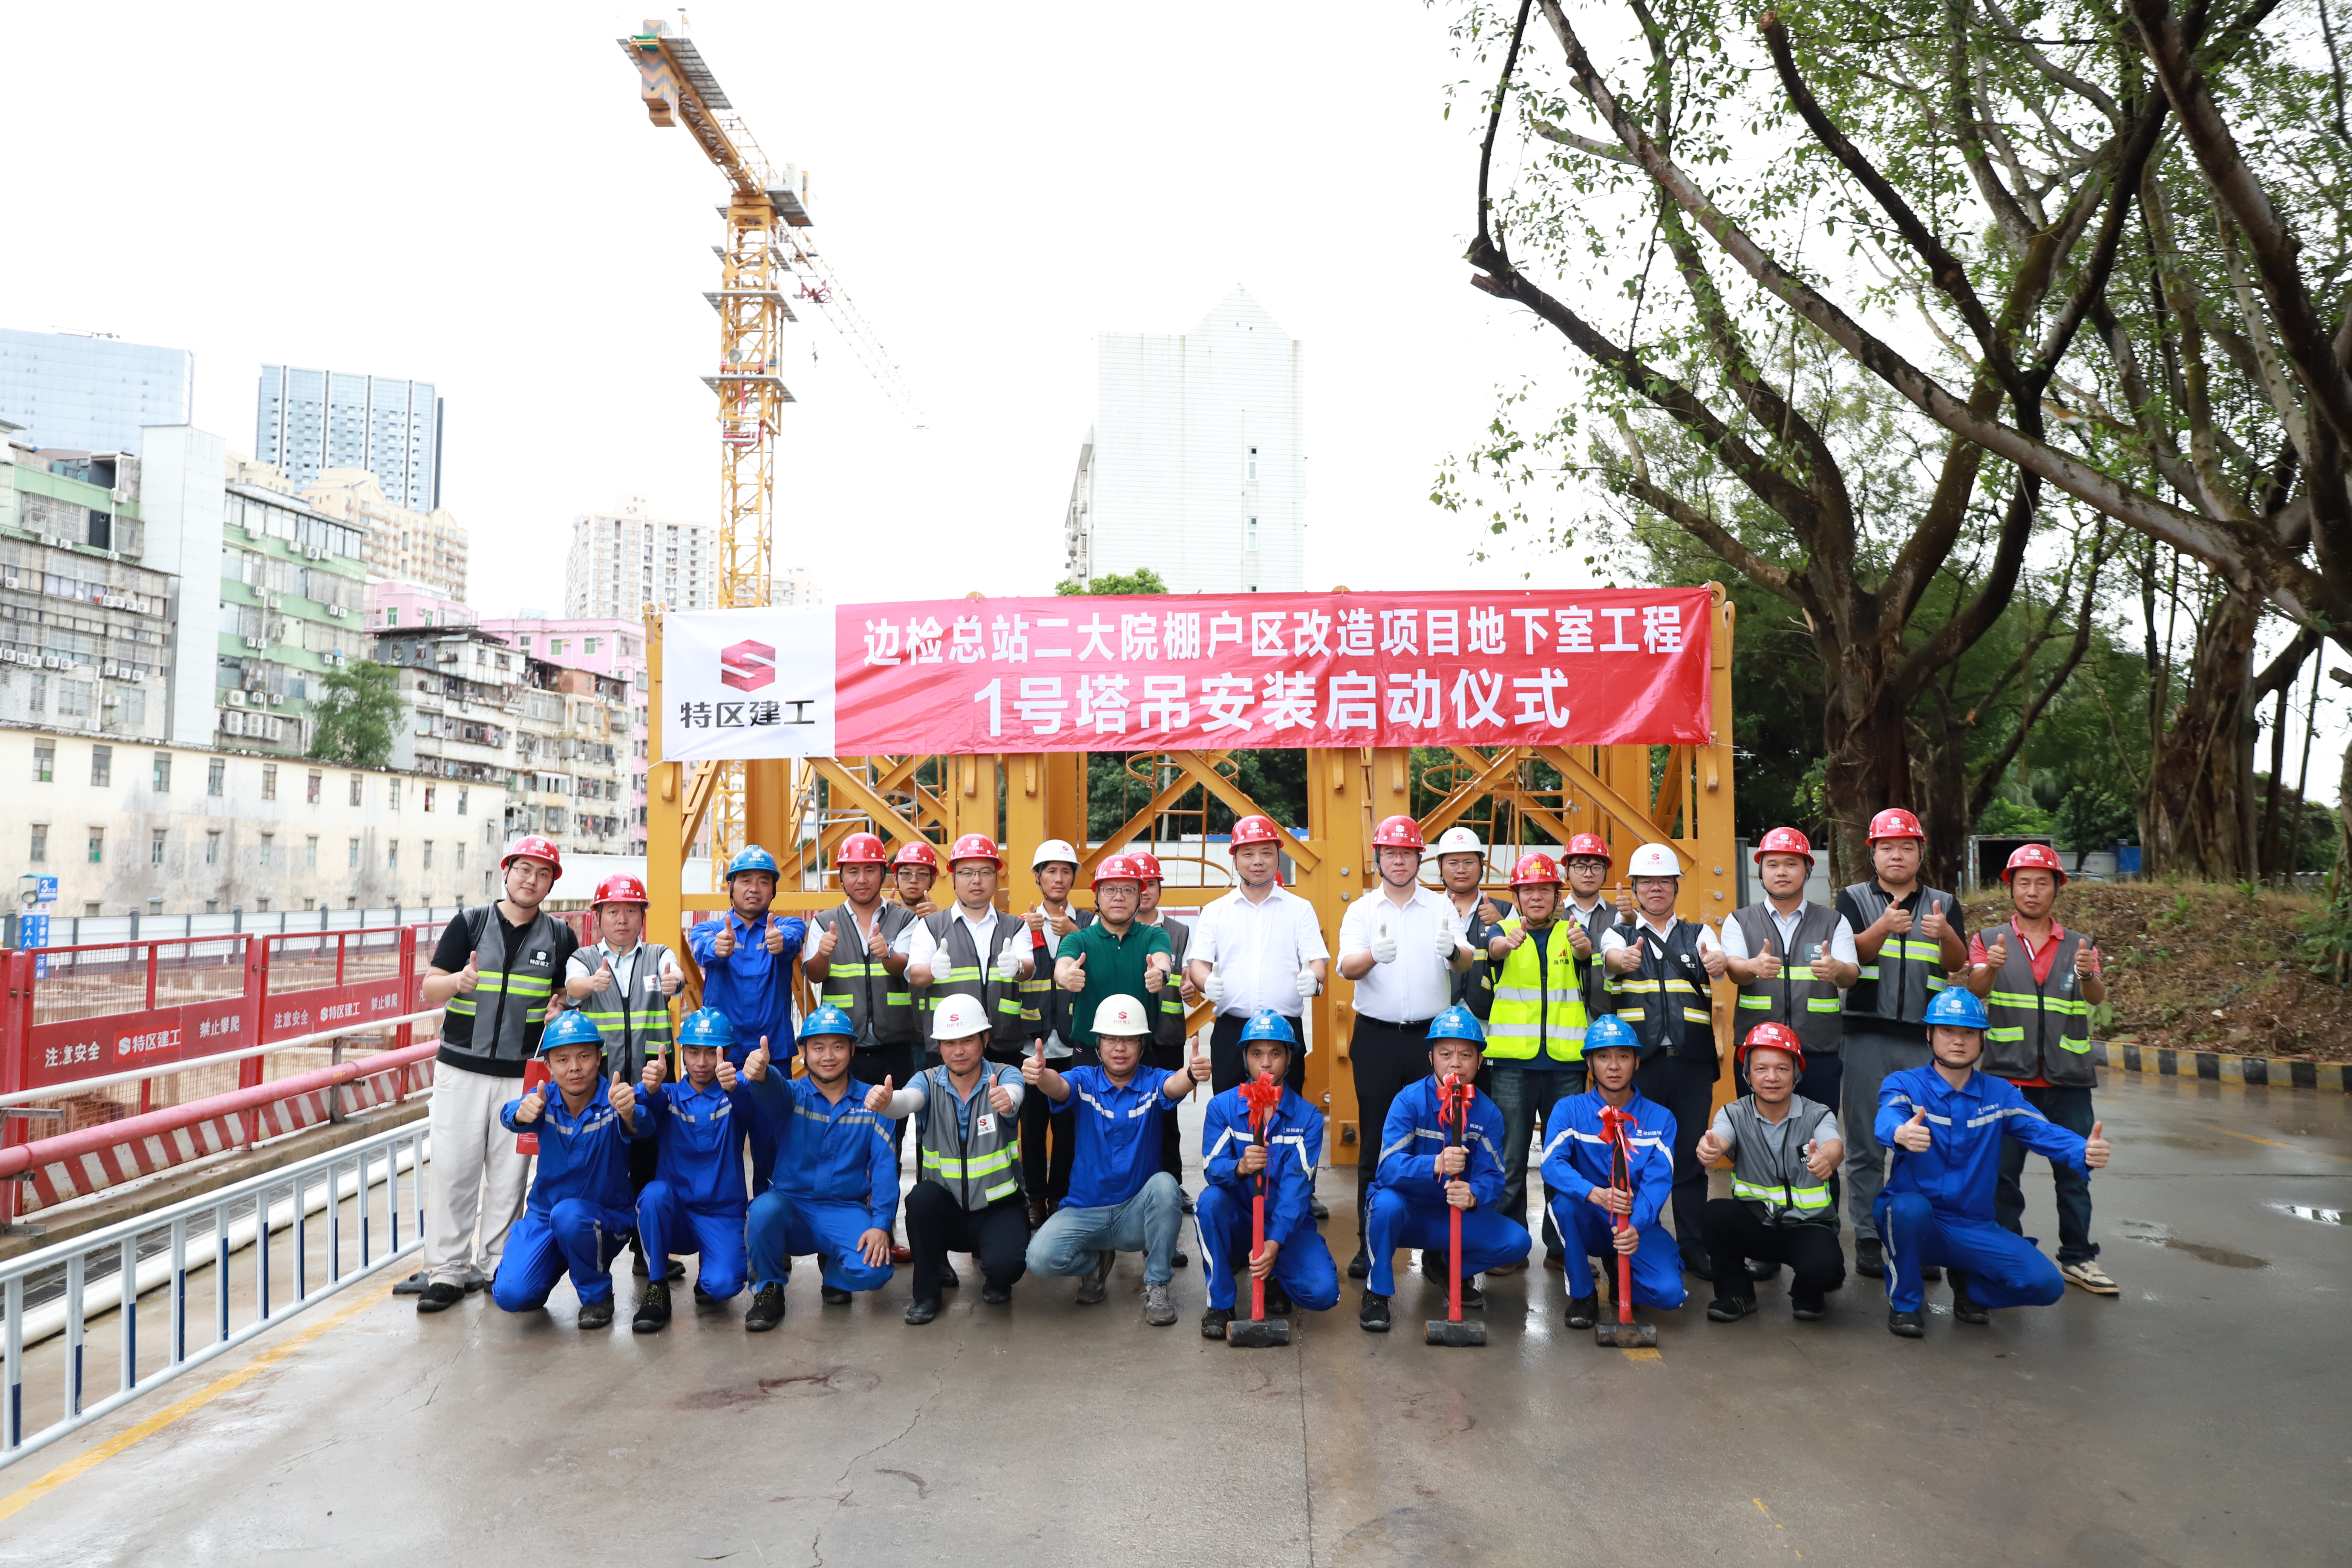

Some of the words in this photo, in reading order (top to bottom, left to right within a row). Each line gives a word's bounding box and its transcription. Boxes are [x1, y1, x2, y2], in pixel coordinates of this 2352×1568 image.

[864, 605, 1683, 667] 边检总站二大院棚户区改造项目地下室工程
[680, 700, 815, 728] 特区建工
[974, 668, 1570, 737] 1号塔吊安装启动仪式
[530, 959, 550, 967] 特区建工
[274, 1009, 309, 1029] 注意安全
[329, 1002, 360, 1020] 特区建工
[371, 993, 398, 1011] 禁止攀爬
[44, 1041, 100, 1068] 注意安全
[132, 1029, 181, 1053] 特区建工
[200, 1015, 240, 1038] 禁止攀爬
